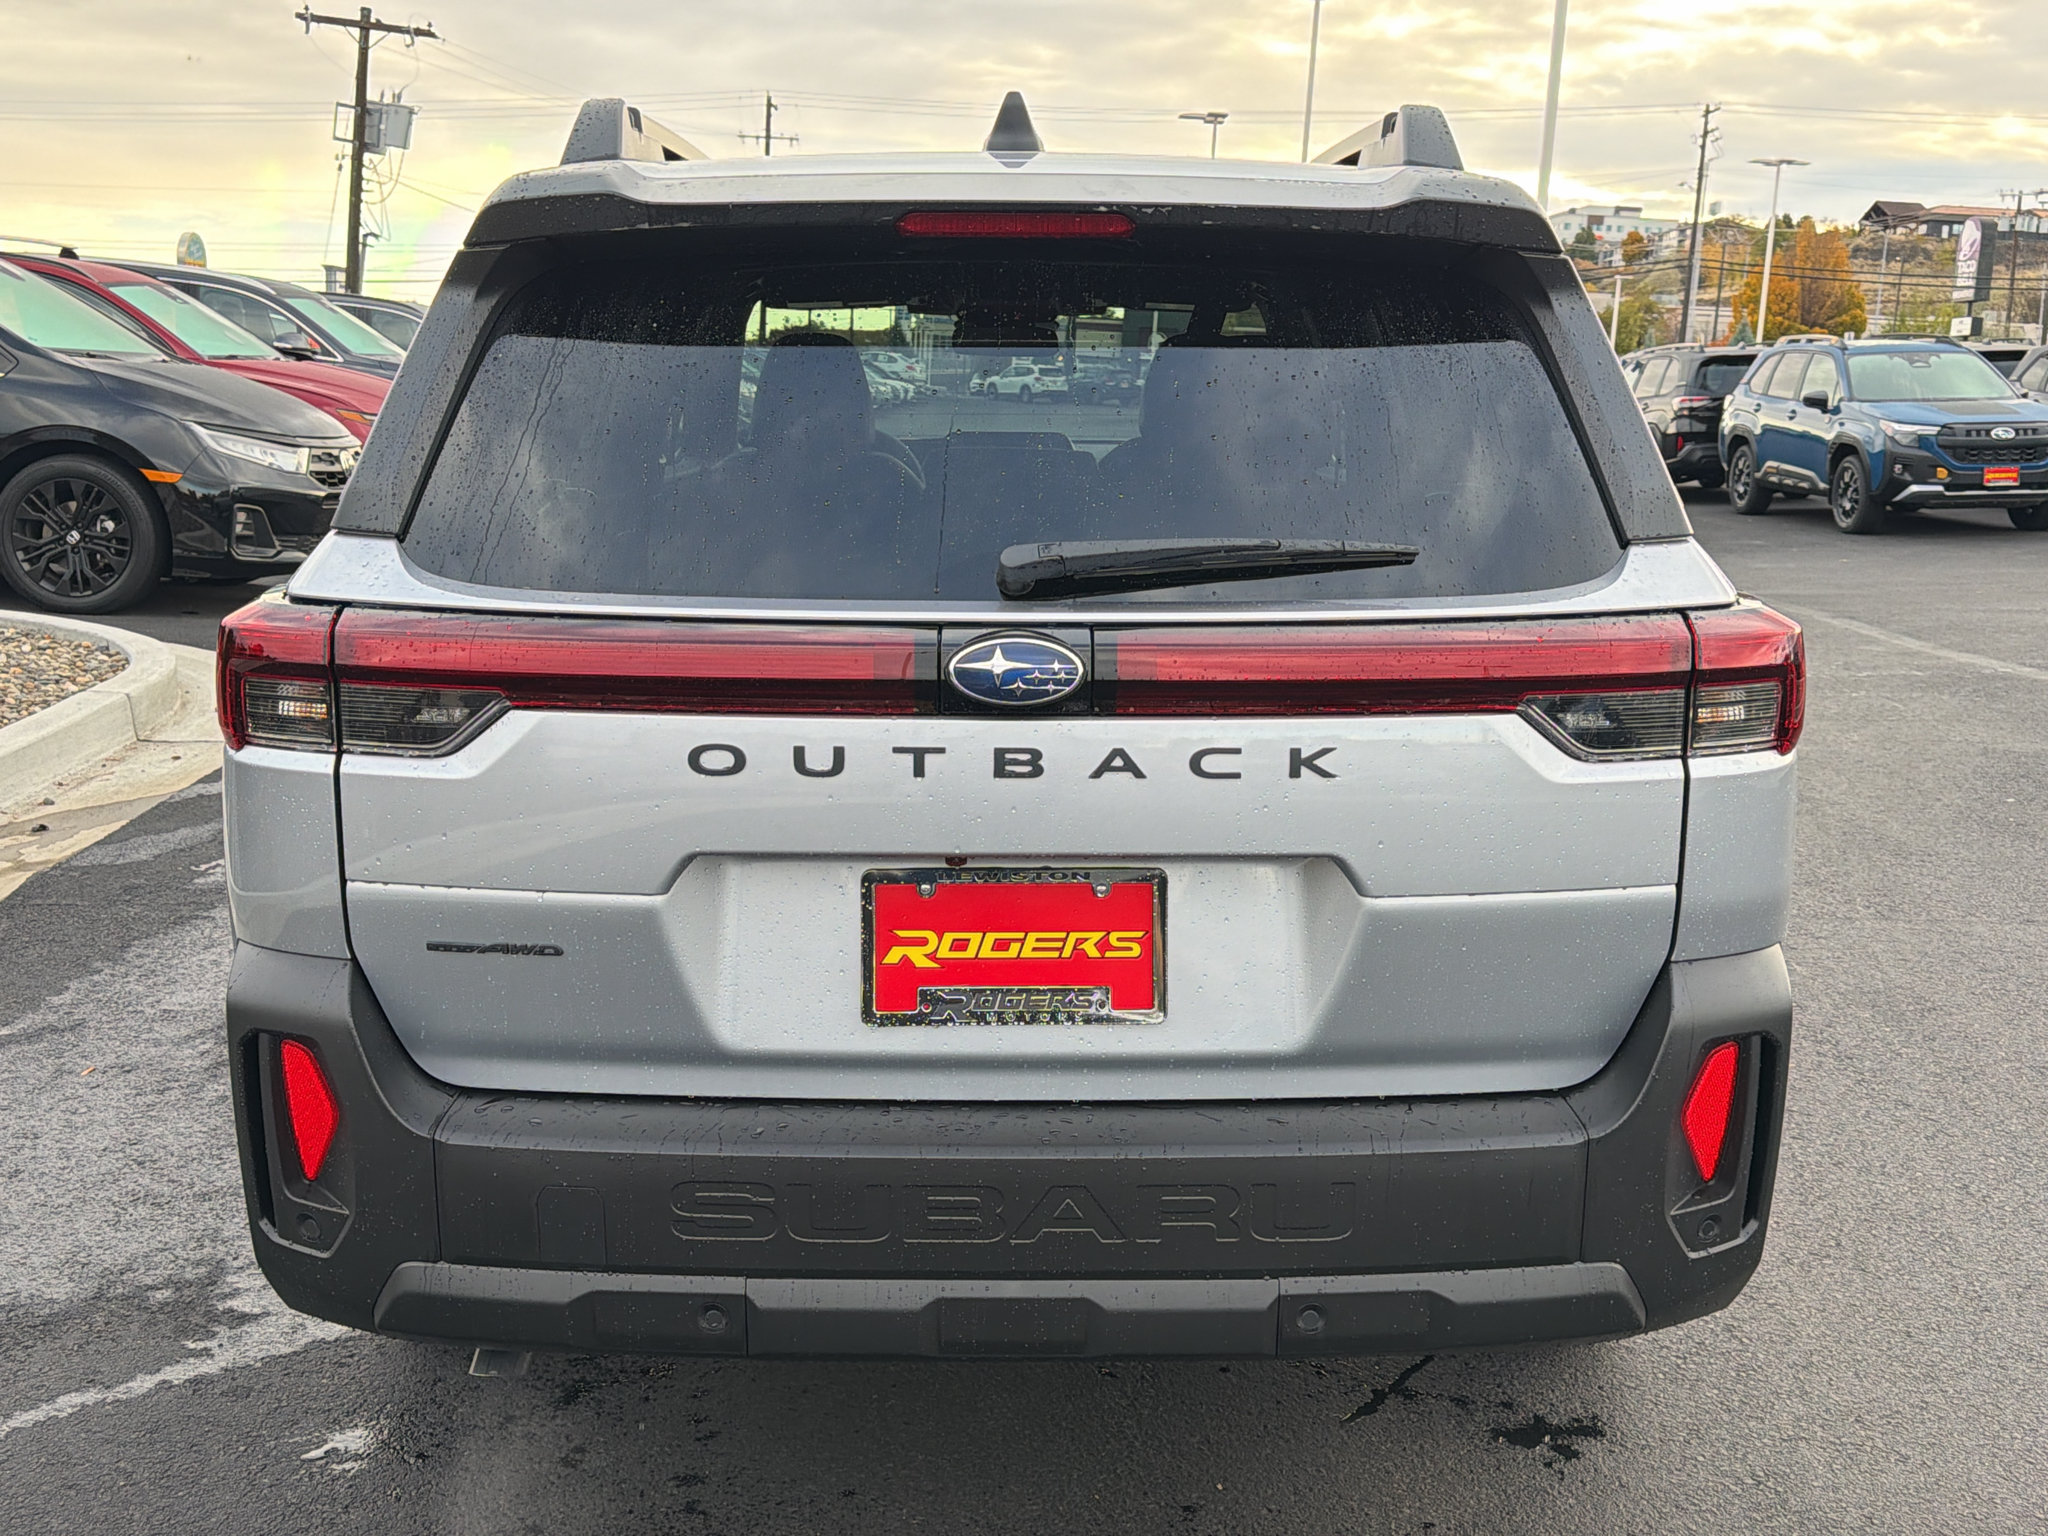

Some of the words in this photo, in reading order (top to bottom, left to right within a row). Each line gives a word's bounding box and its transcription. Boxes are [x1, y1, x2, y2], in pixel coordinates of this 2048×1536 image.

[687, 744, 1339, 778] OUTBACK
[937, 871, 1091, 883] LEWISTON
[880, 930, 1149, 968] ROGERS
[929, 991, 1099, 1022] ROGERS
[670, 1181, 1356, 1243] SUBARU
